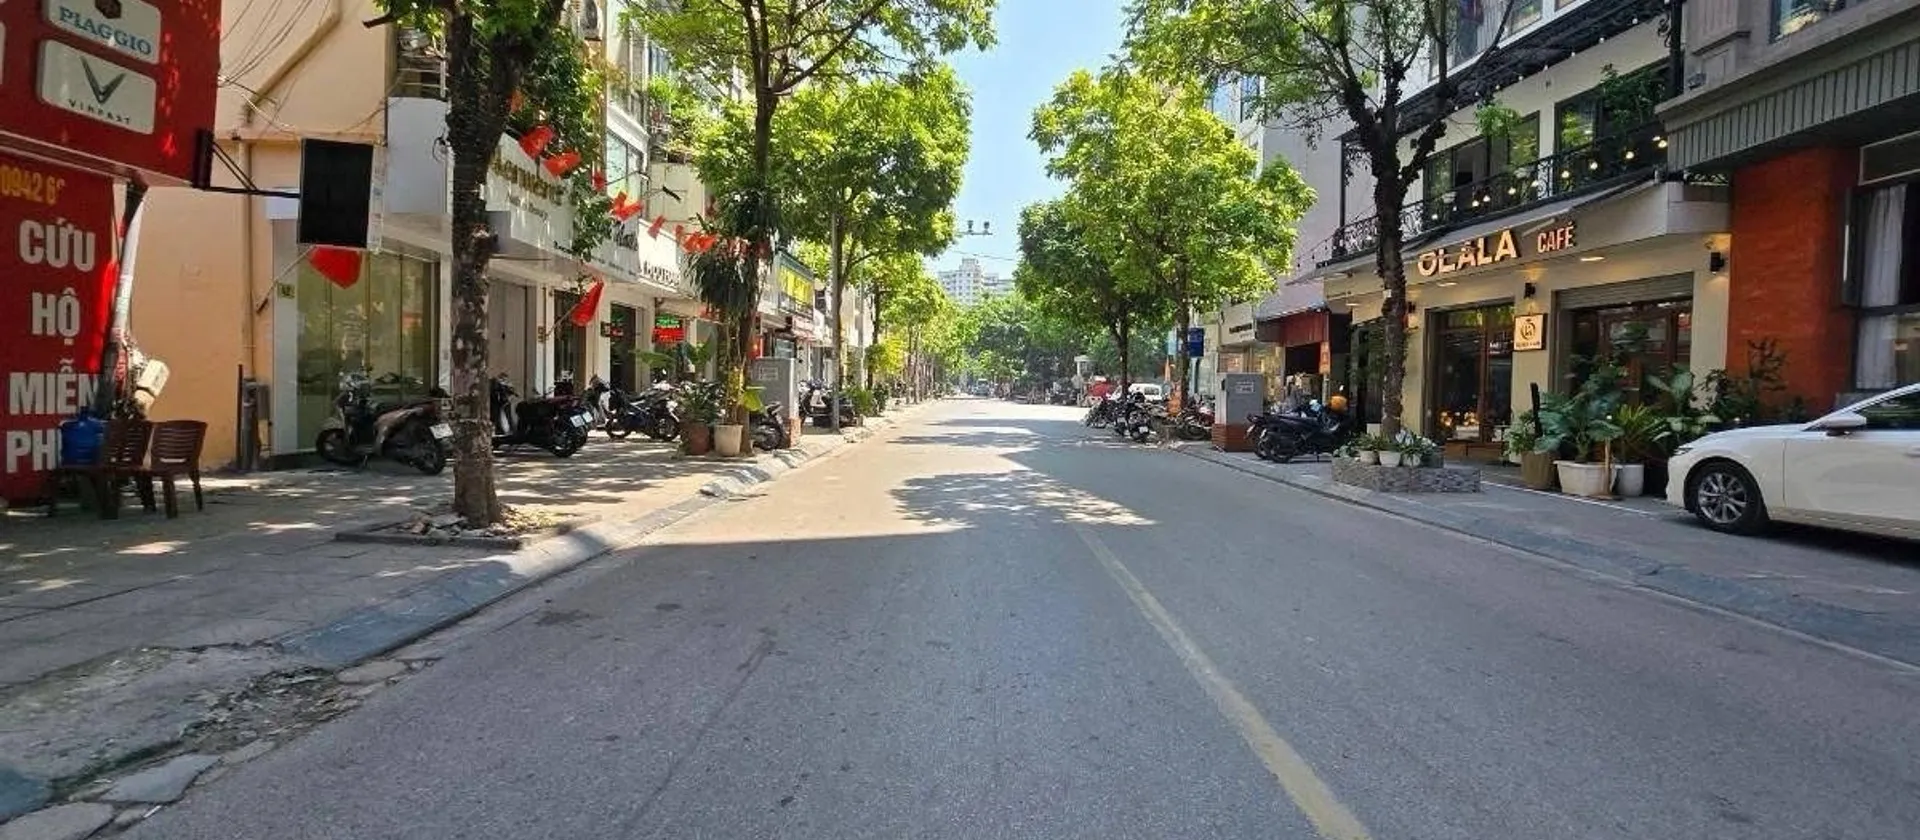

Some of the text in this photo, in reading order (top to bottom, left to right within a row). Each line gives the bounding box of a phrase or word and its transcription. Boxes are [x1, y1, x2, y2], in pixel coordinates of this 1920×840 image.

[58, 6, 152, 55] PIAGGIO
[68, 98, 131, 125] VINFAST
[1, 164, 43, 203] 0942
[20, 217, 97, 272] CỨU
[1417, 221, 1575, 277] OLALA CAFÉ
[31, 286, 80, 346] HỘ
[9, 358, 100, 415] MIỄN
